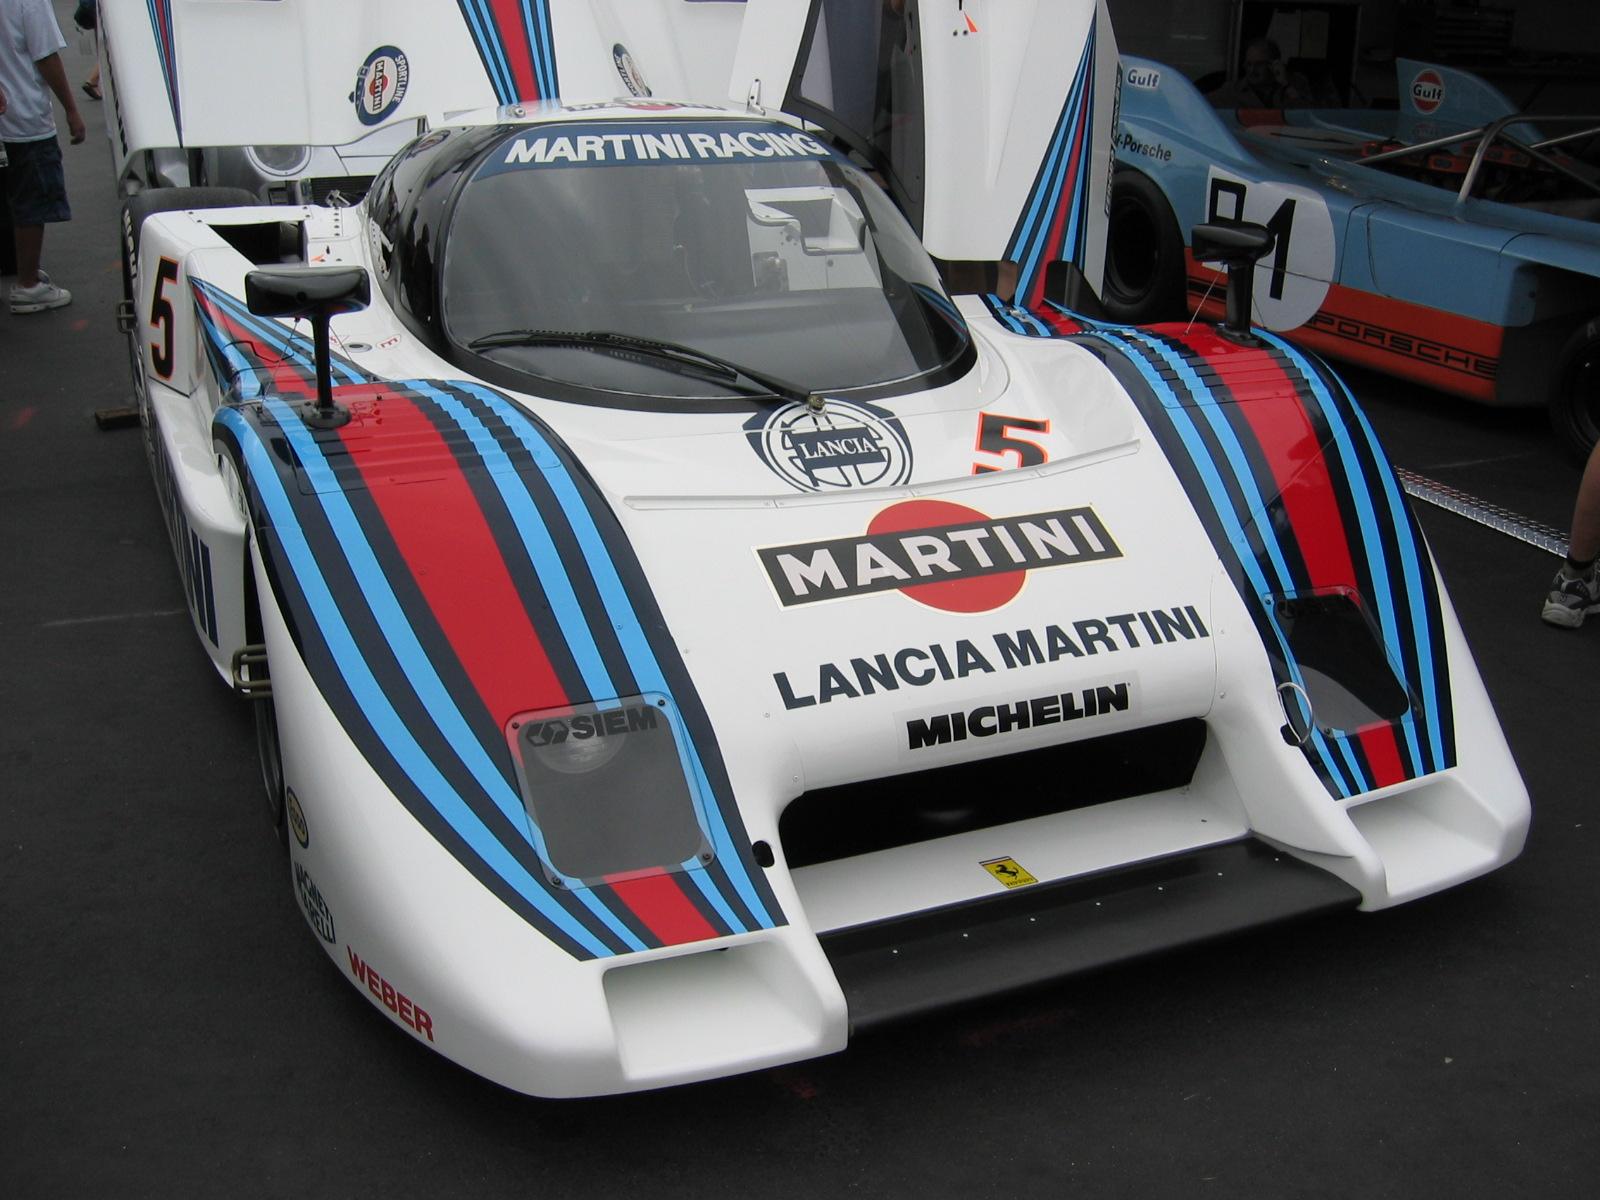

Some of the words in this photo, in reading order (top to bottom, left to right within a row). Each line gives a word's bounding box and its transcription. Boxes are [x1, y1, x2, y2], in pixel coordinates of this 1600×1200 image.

[373, 61, 384, 110] MARTINI
[394, 54, 408, 102] SPORTLINE
[1127, 68, 1160, 88] Gulf
[1413, 84, 1442, 99] Gulf
[504, 133, 690, 163] MARTINI
[688, 131, 831, 158] RACING
[150, 256, 179, 381] 5
[1310, 314, 1500, 376] PORSCHE
[799, 437, 878, 459] LANCIA
[971, 411, 1051, 476] 5
[776, 514, 1107, 597] MARTINI
[773, 638, 996, 711] LANCIA
[992, 605, 1210, 669] MARTINI
[571, 706, 657, 740] SIEM
[907, 682, 1130, 750] MICHELIN
[347, 944, 434, 1042] WEBER
